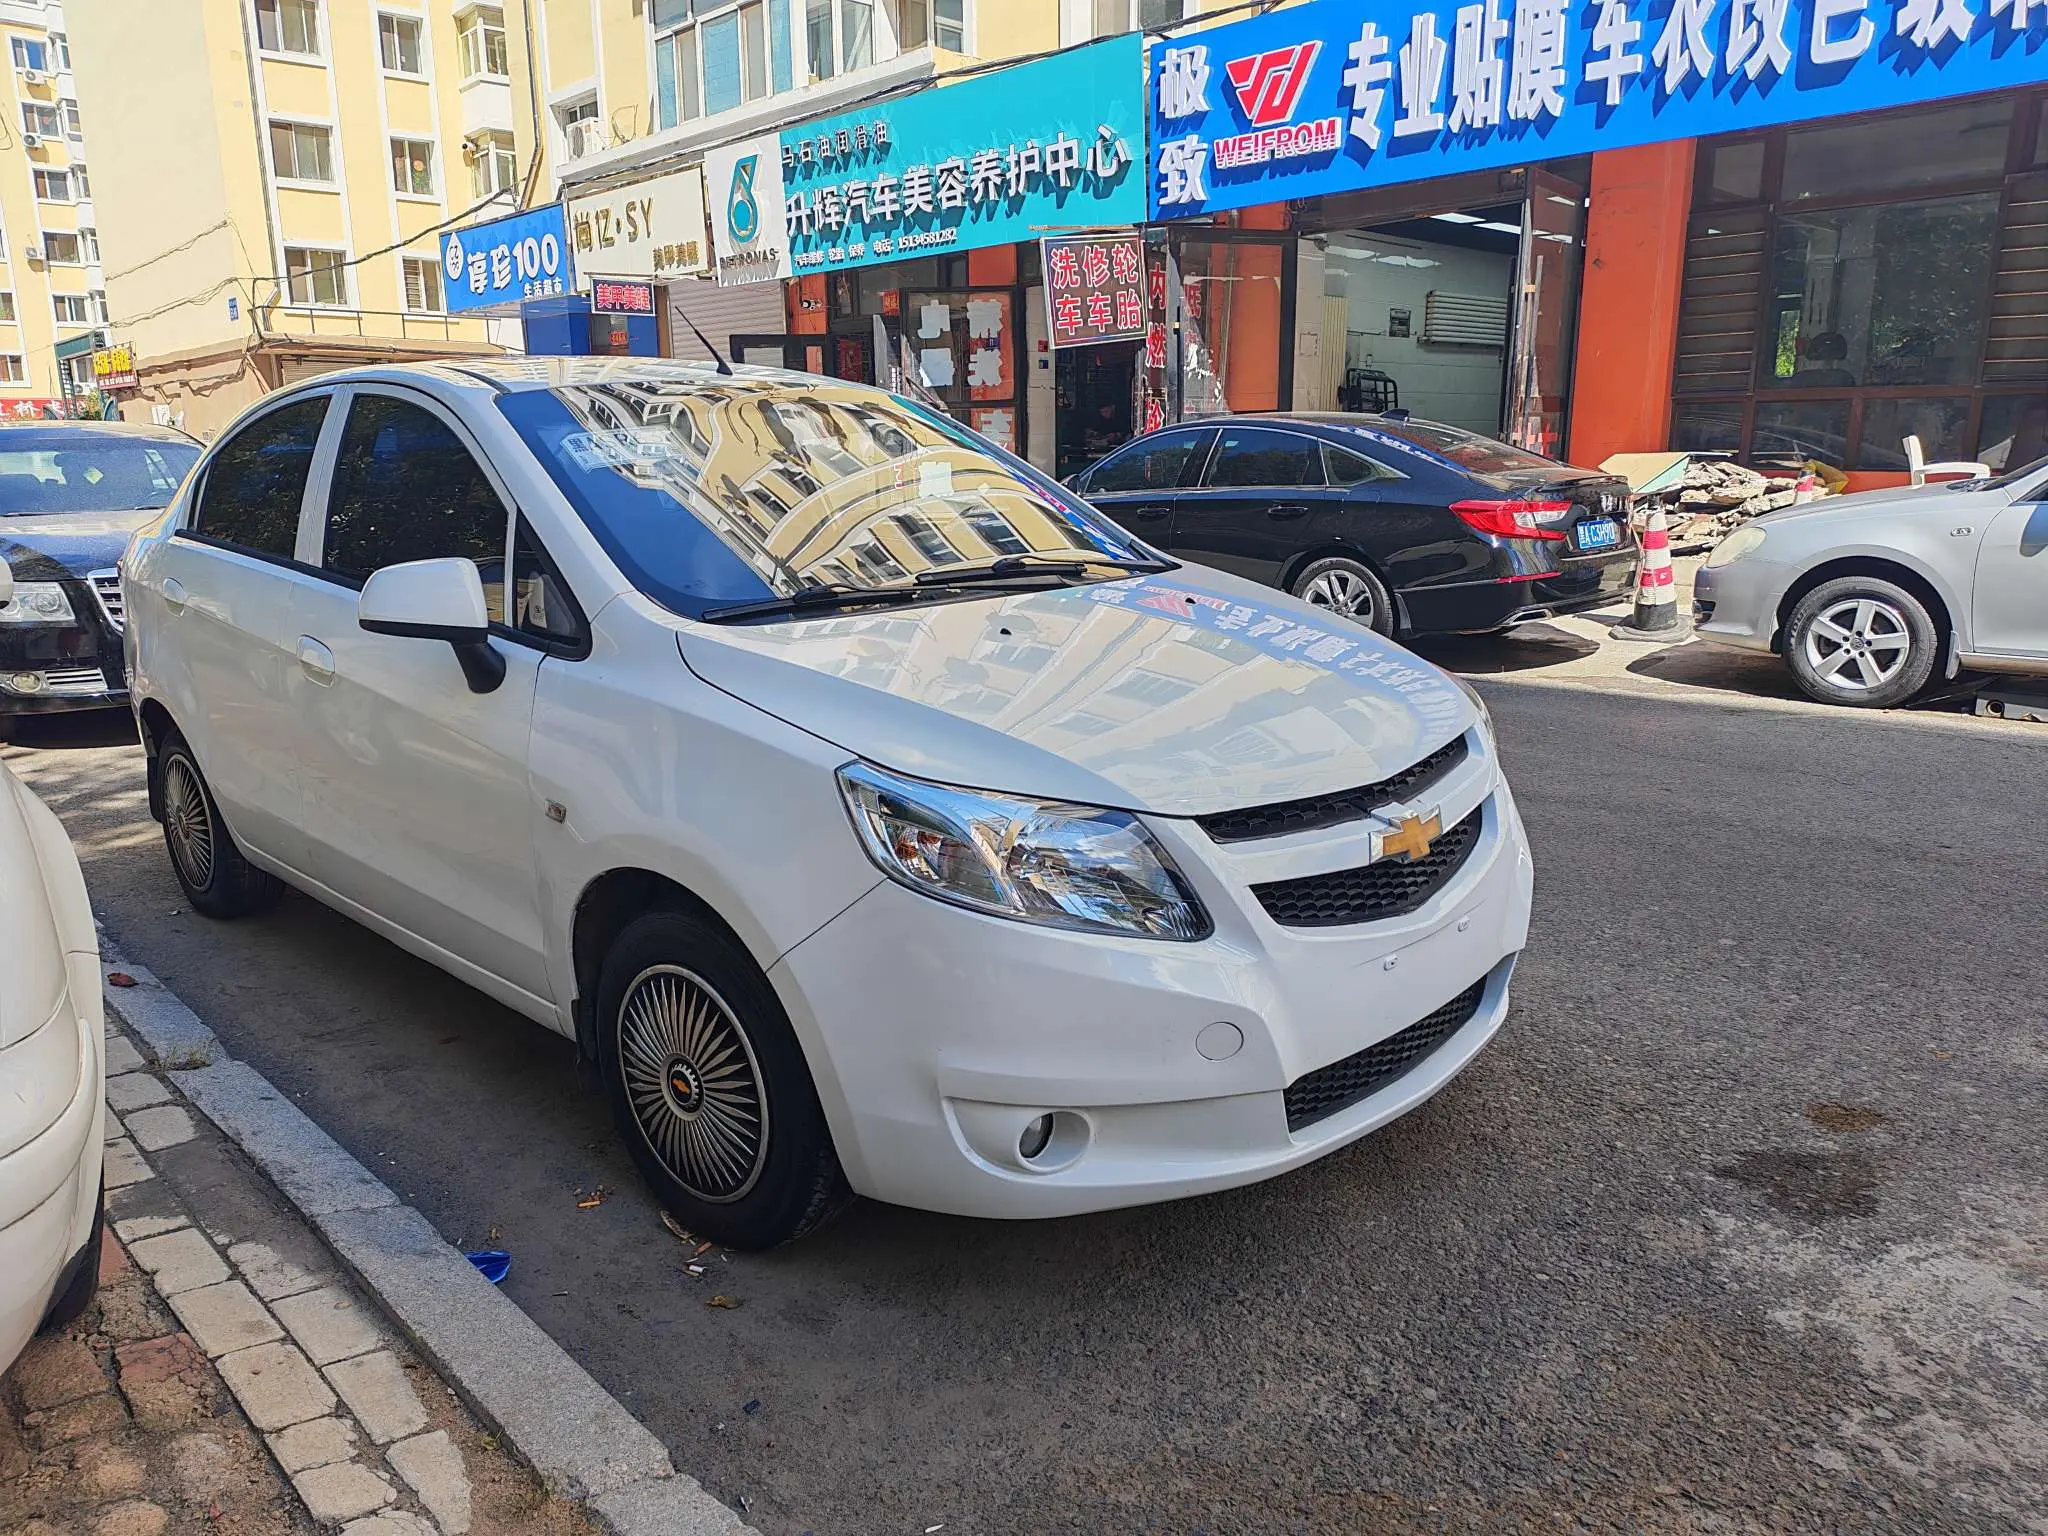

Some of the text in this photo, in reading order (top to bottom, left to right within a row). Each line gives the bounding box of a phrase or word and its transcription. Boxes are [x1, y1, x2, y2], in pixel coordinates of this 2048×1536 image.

[781, 120, 888, 168] 马石油润滑油
[1159, 45, 1210, 206] 极致
[1214, 117, 1342, 169] WEIFROM
[785, 124, 1131, 236] 升辉汽车美容养护中心
[720, 248, 779, 270] PETRONAS
